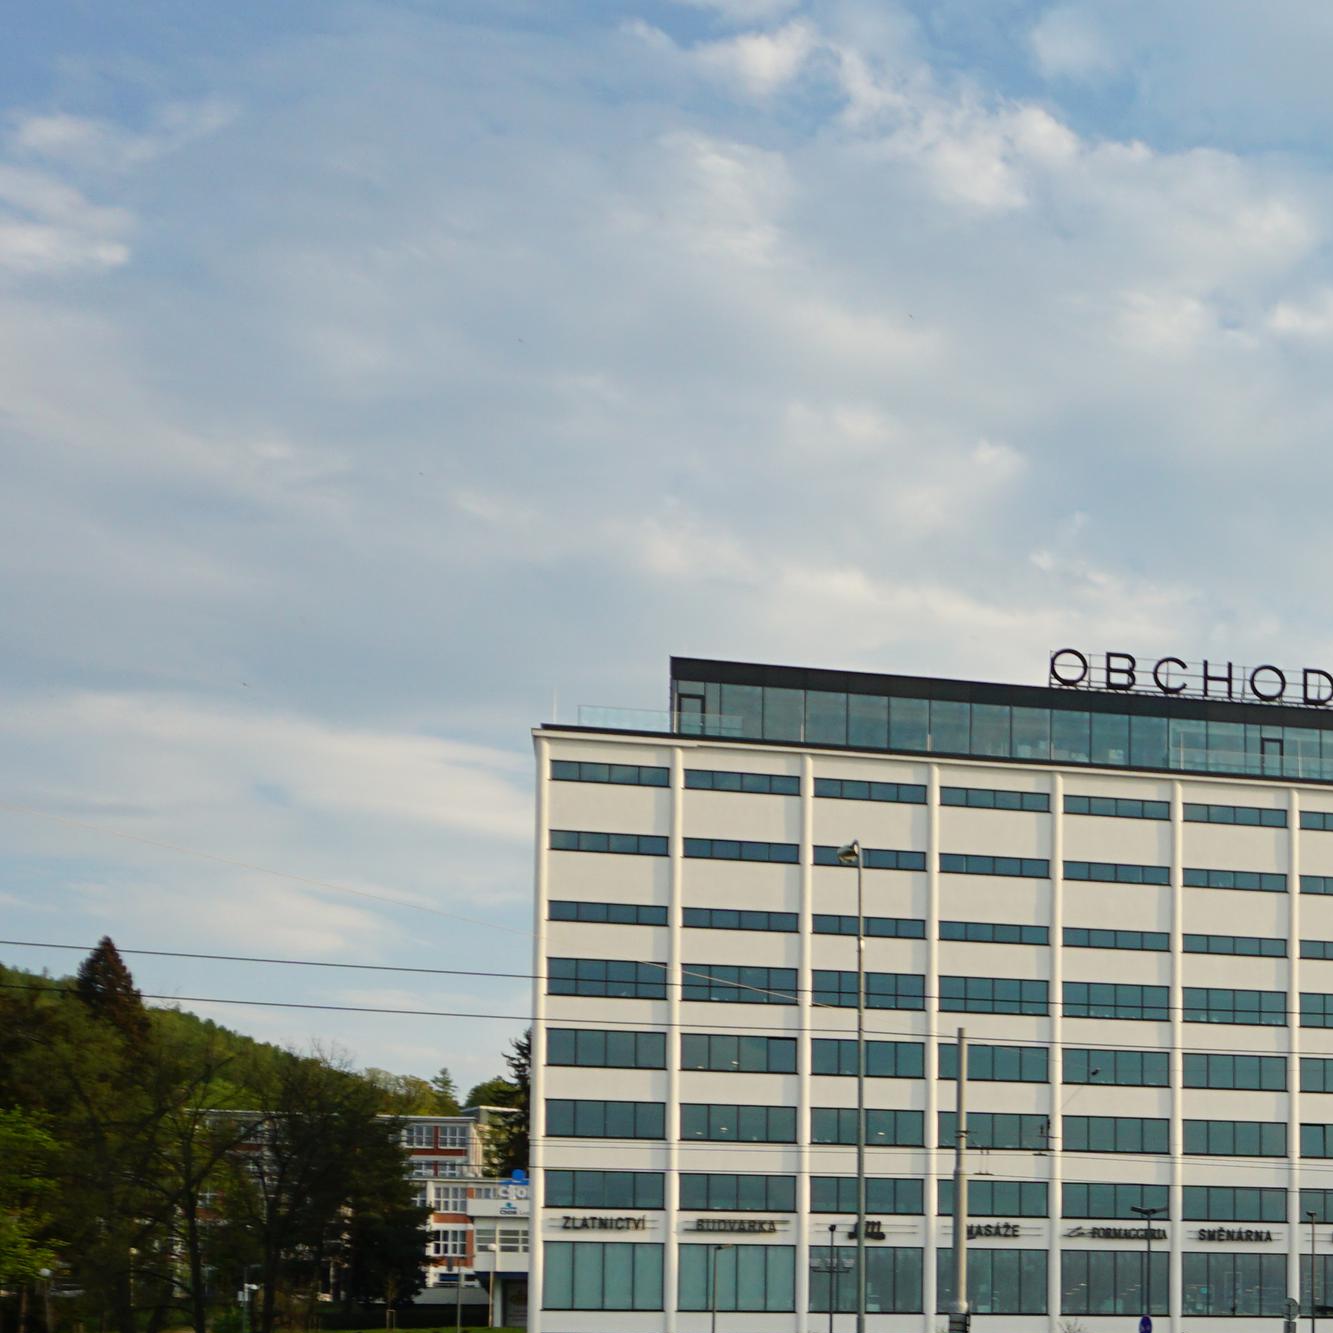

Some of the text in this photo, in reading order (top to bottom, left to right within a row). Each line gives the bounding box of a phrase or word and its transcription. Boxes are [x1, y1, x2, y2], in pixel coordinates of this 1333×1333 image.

[562, 1215, 647, 1231] ZLATNICTVÍ
[696, 1219, 777, 1233] BUDVARKA
[1199, 1226, 1272, 1242] SMĚNÁRNA
